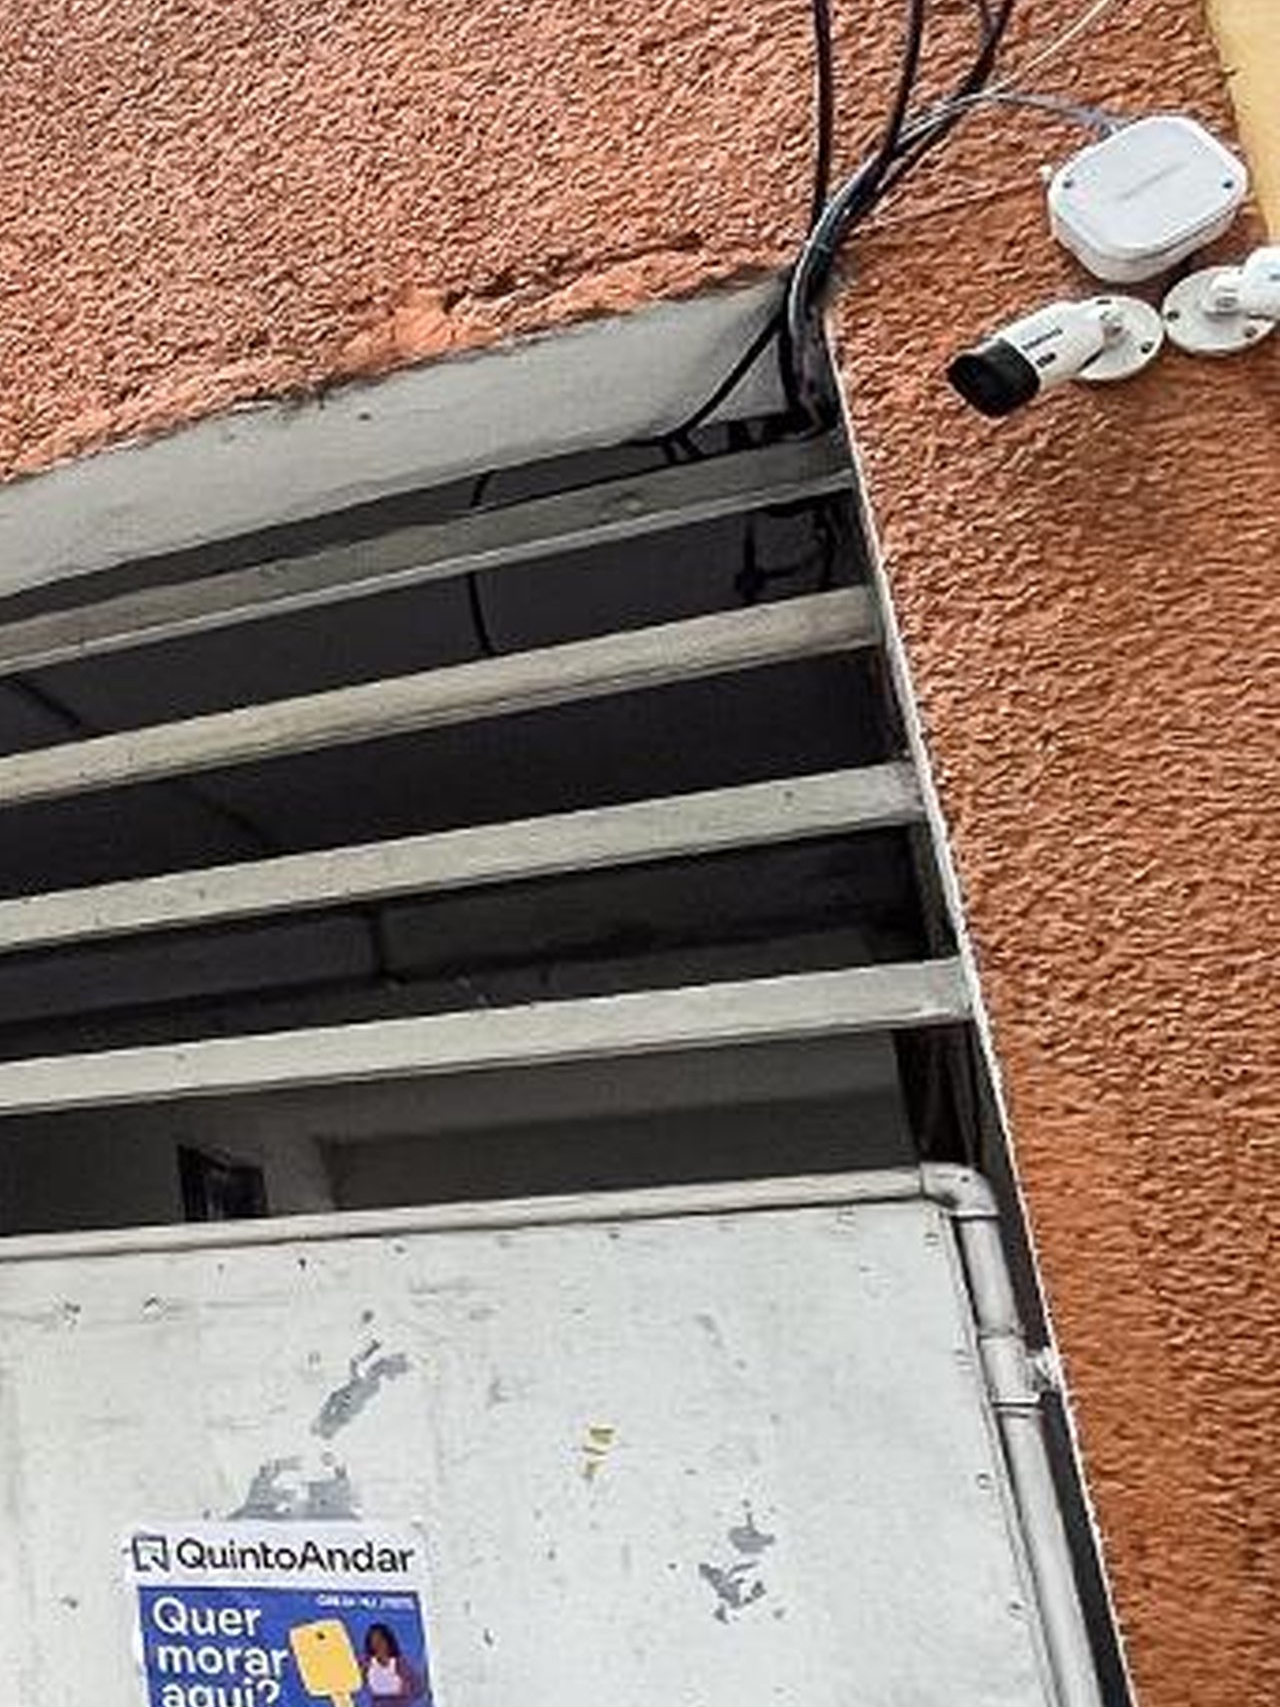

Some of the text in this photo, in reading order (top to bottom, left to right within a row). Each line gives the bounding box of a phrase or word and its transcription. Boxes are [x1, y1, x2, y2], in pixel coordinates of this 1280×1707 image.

[176, 1537, 416, 1574] QuintoAndar
[153, 1596, 262, 1637] Quer
[157, 1645, 289, 1680] morar
